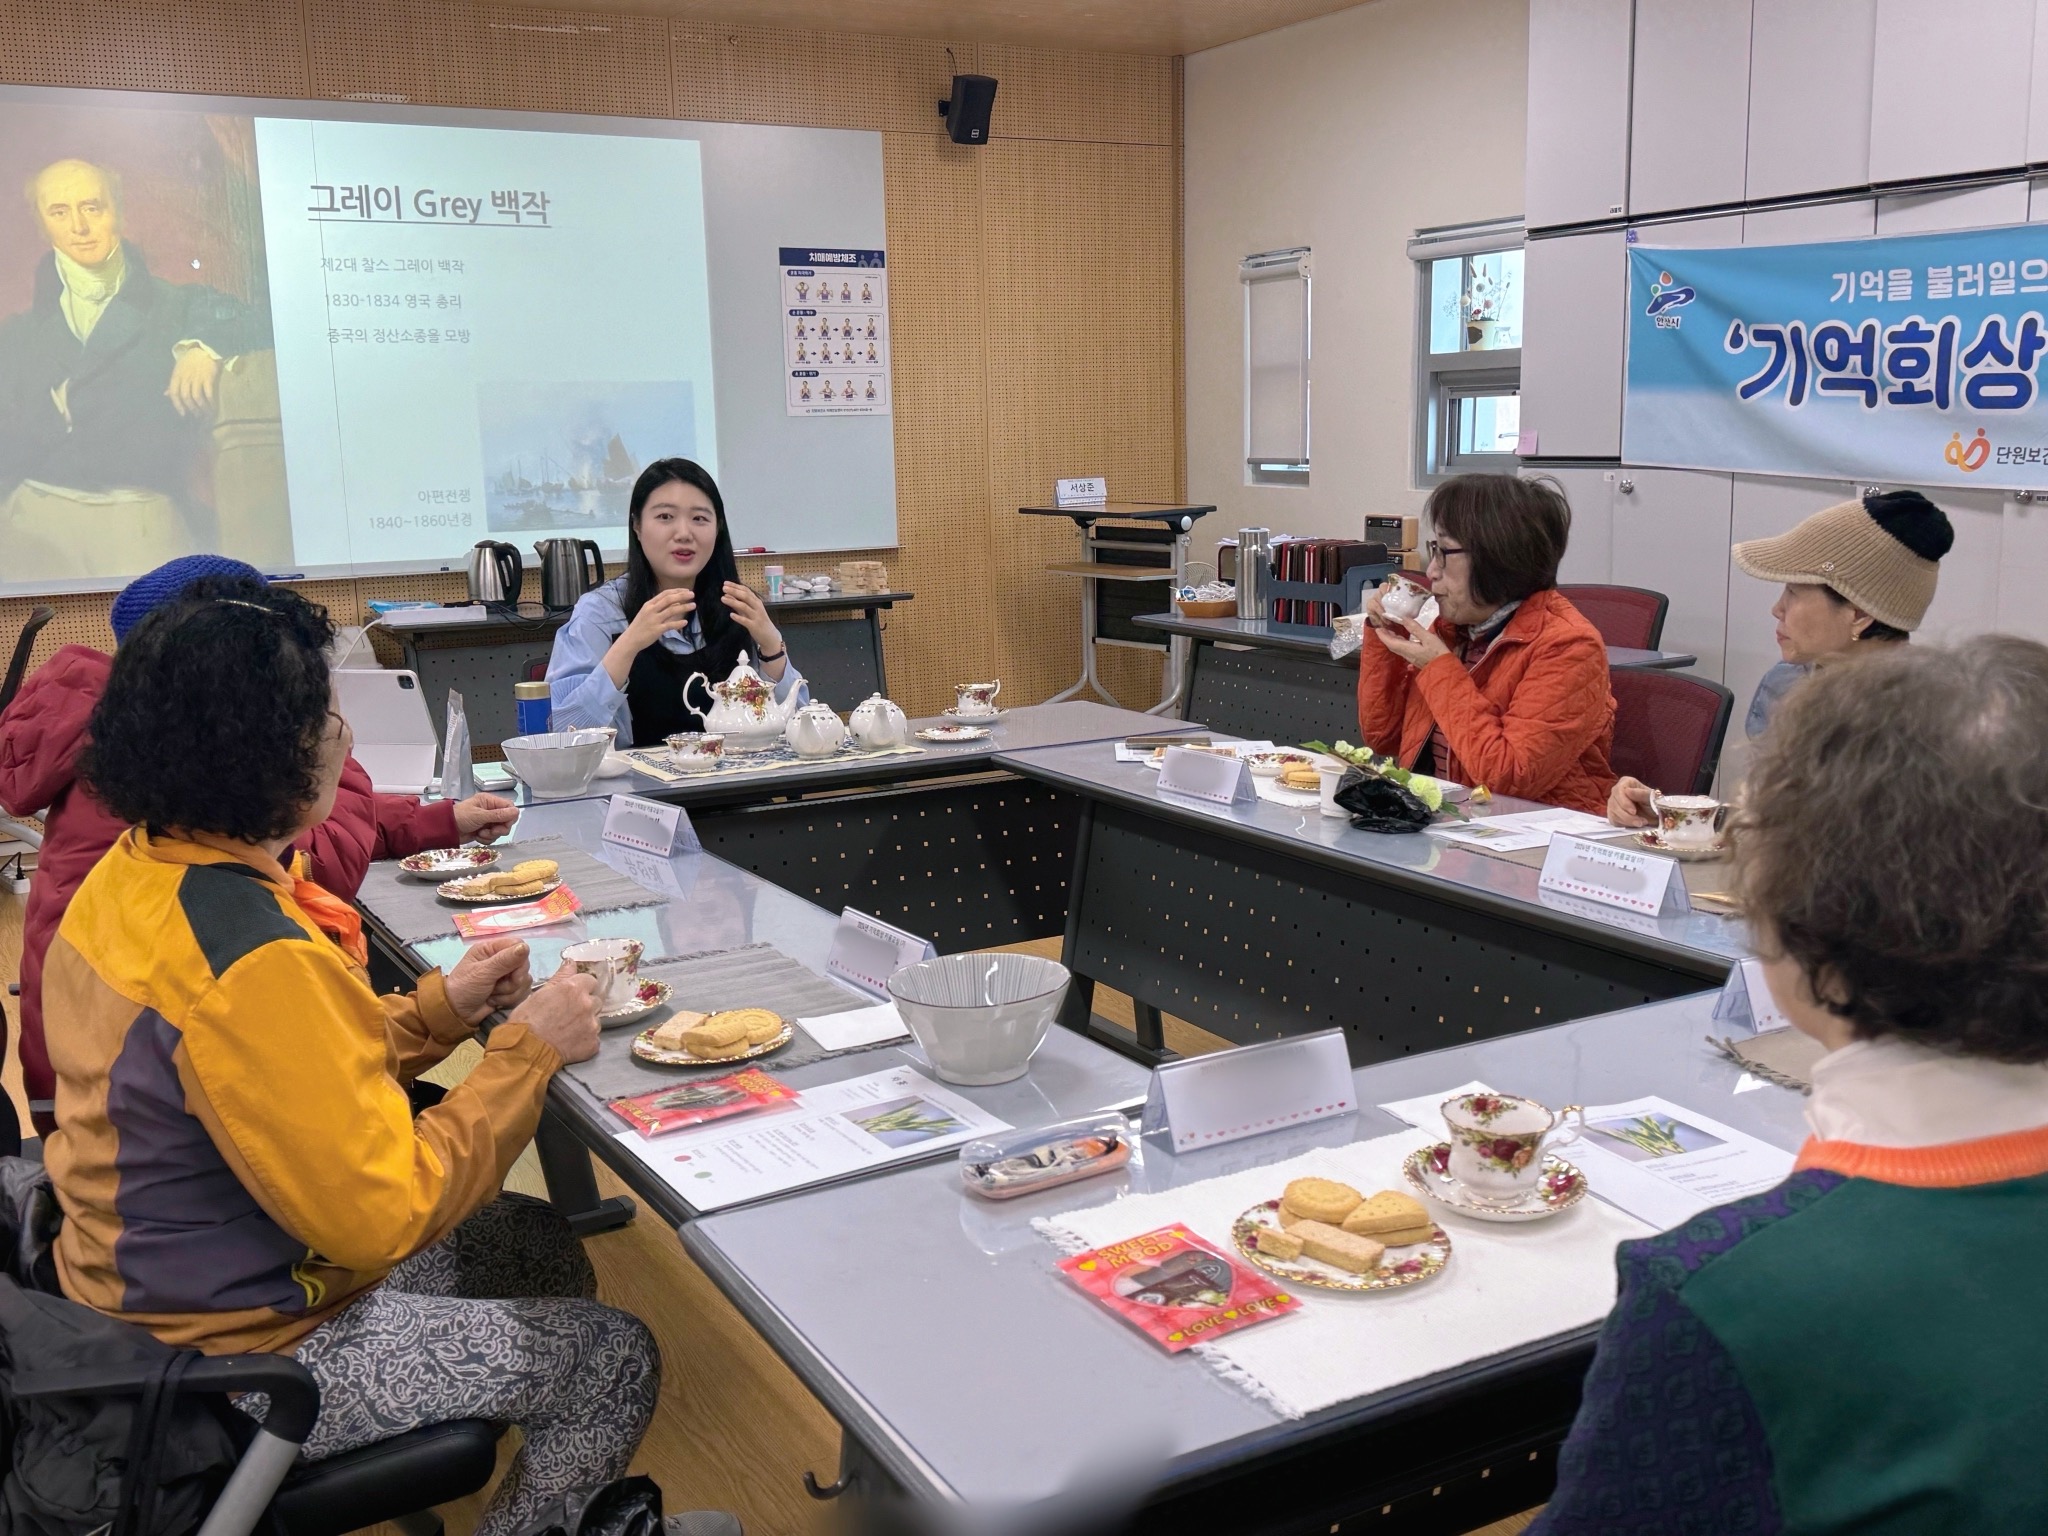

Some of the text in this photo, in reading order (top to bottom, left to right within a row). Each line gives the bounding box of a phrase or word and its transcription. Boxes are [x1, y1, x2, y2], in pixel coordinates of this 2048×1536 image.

[307, 184, 551, 224] 그레이 Grey 백작
[321, 257, 465, 275] 제2대 찰스 그레이 백작
[1829, 258, 2048, 304] 기억을 불러일으
[325, 293, 463, 309] 1830-1834 영국 총리
[327, 327, 471, 344] 중국의 정산소종을 모방
[417, 487, 472, 505] 아편전쟁
[368, 513, 472, 529] 1840~1860년경
[1098, 1231, 1161, 1261] SWEET
[1109, 1240, 1174, 1269] MOOD
[1183, 1298, 1277, 1338] LOVE LOVE
